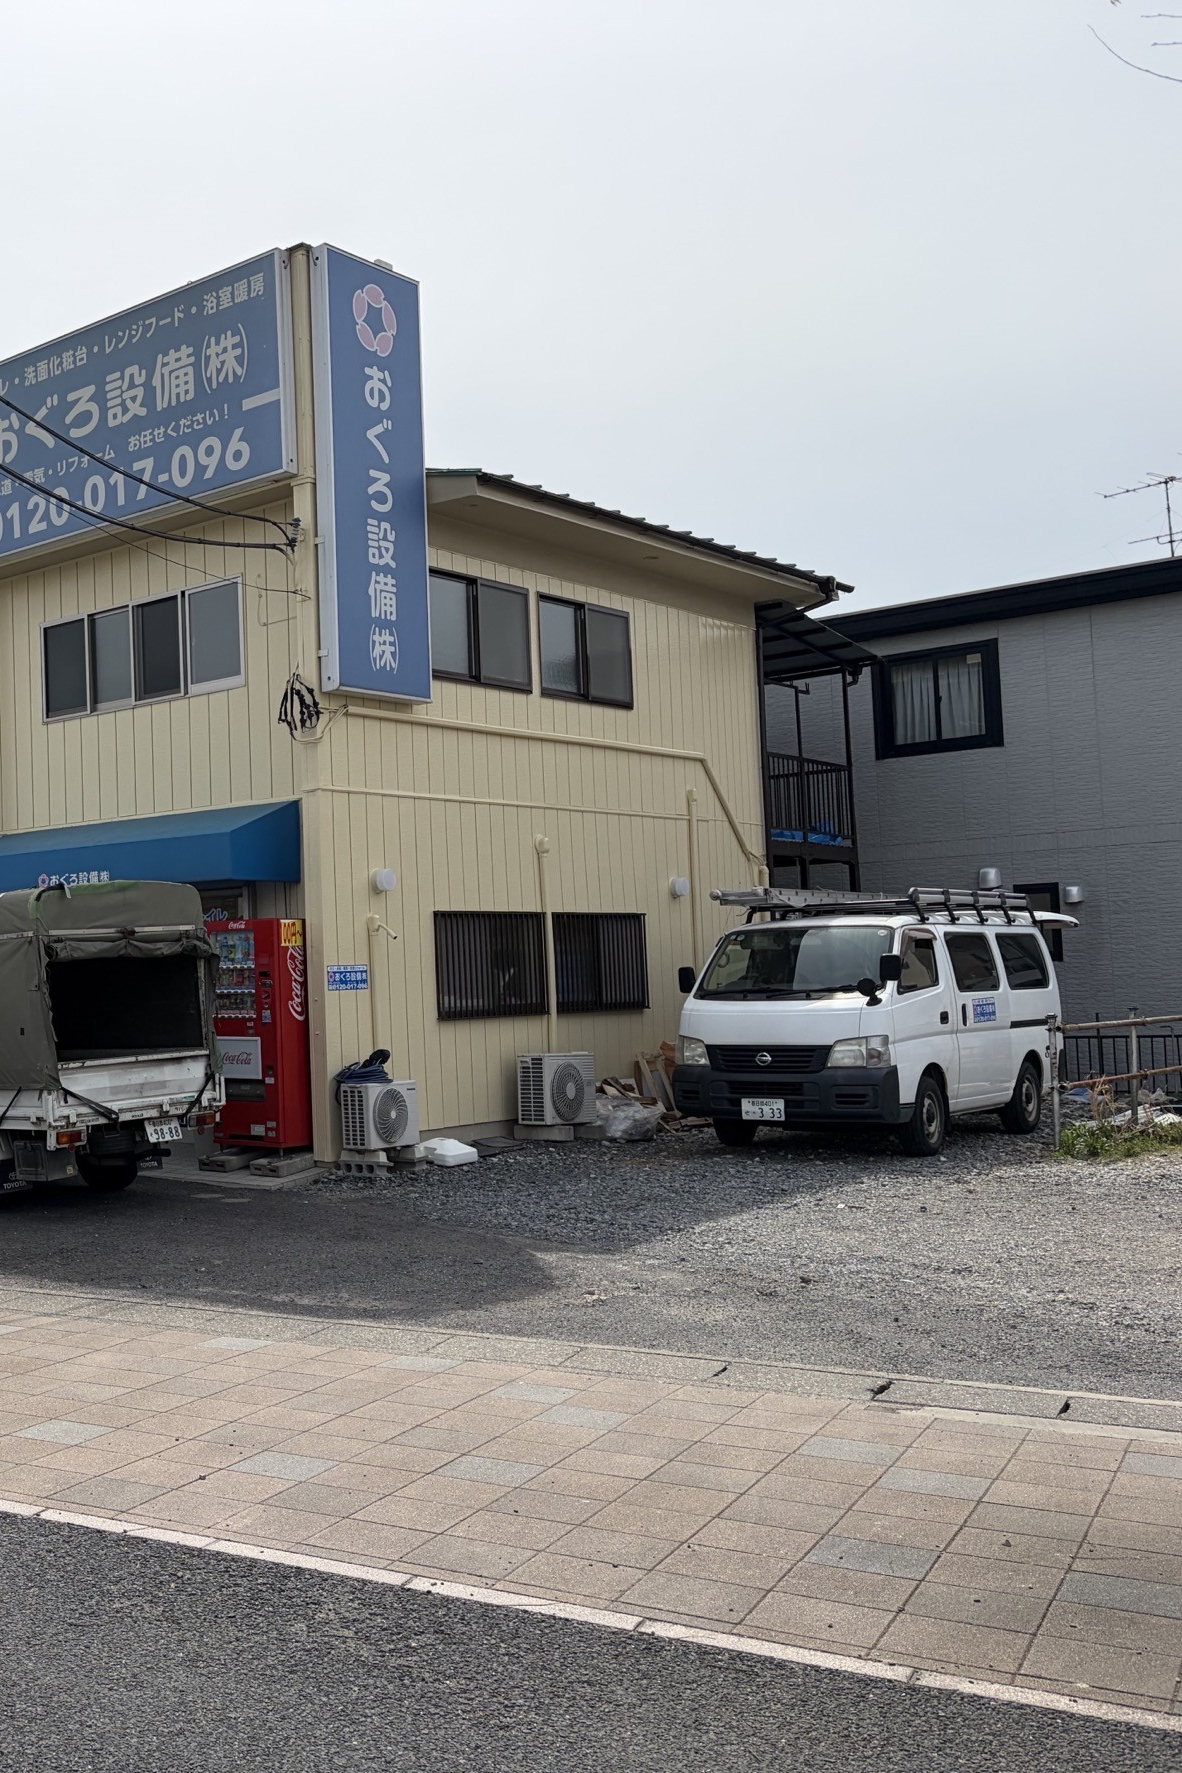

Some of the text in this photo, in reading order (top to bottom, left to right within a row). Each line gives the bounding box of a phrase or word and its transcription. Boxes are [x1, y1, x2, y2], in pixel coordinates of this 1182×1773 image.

[364, 366, 399, 674] おぐろ設備(株)
[154, 1126, 180, 1140] 98-88
[3, 1180, 27, 1190] TOYOTA
